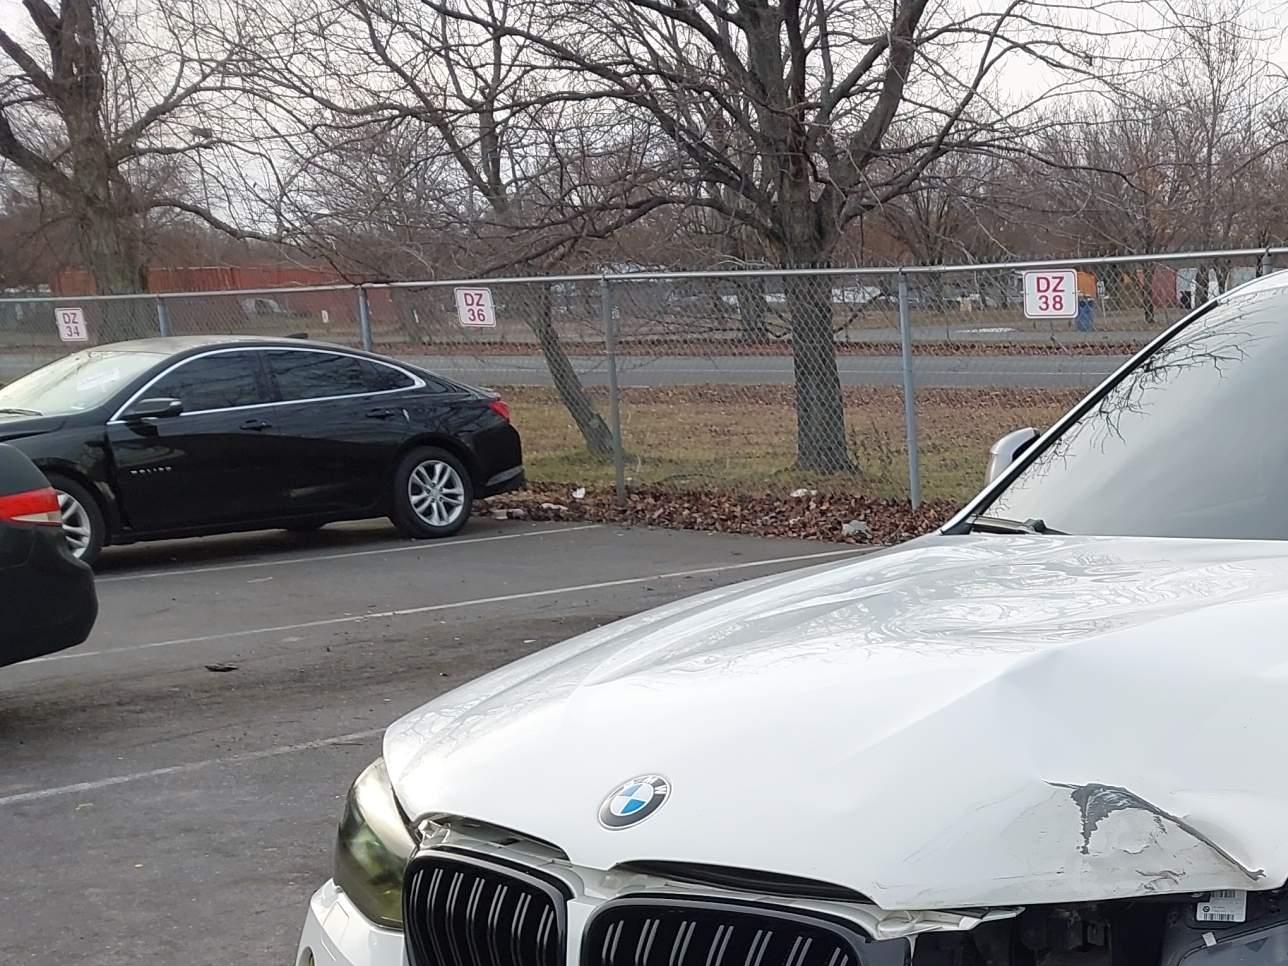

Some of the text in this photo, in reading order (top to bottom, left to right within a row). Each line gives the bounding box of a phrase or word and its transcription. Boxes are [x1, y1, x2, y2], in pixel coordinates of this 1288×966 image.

[1036, 276, 1065, 293] DZ
[464, 293, 485, 306] DZ
[1038, 295, 1064, 311] 38
[62, 312, 79, 324] DZ
[467, 308, 486, 322] 36
[66, 325, 80, 337] 34
